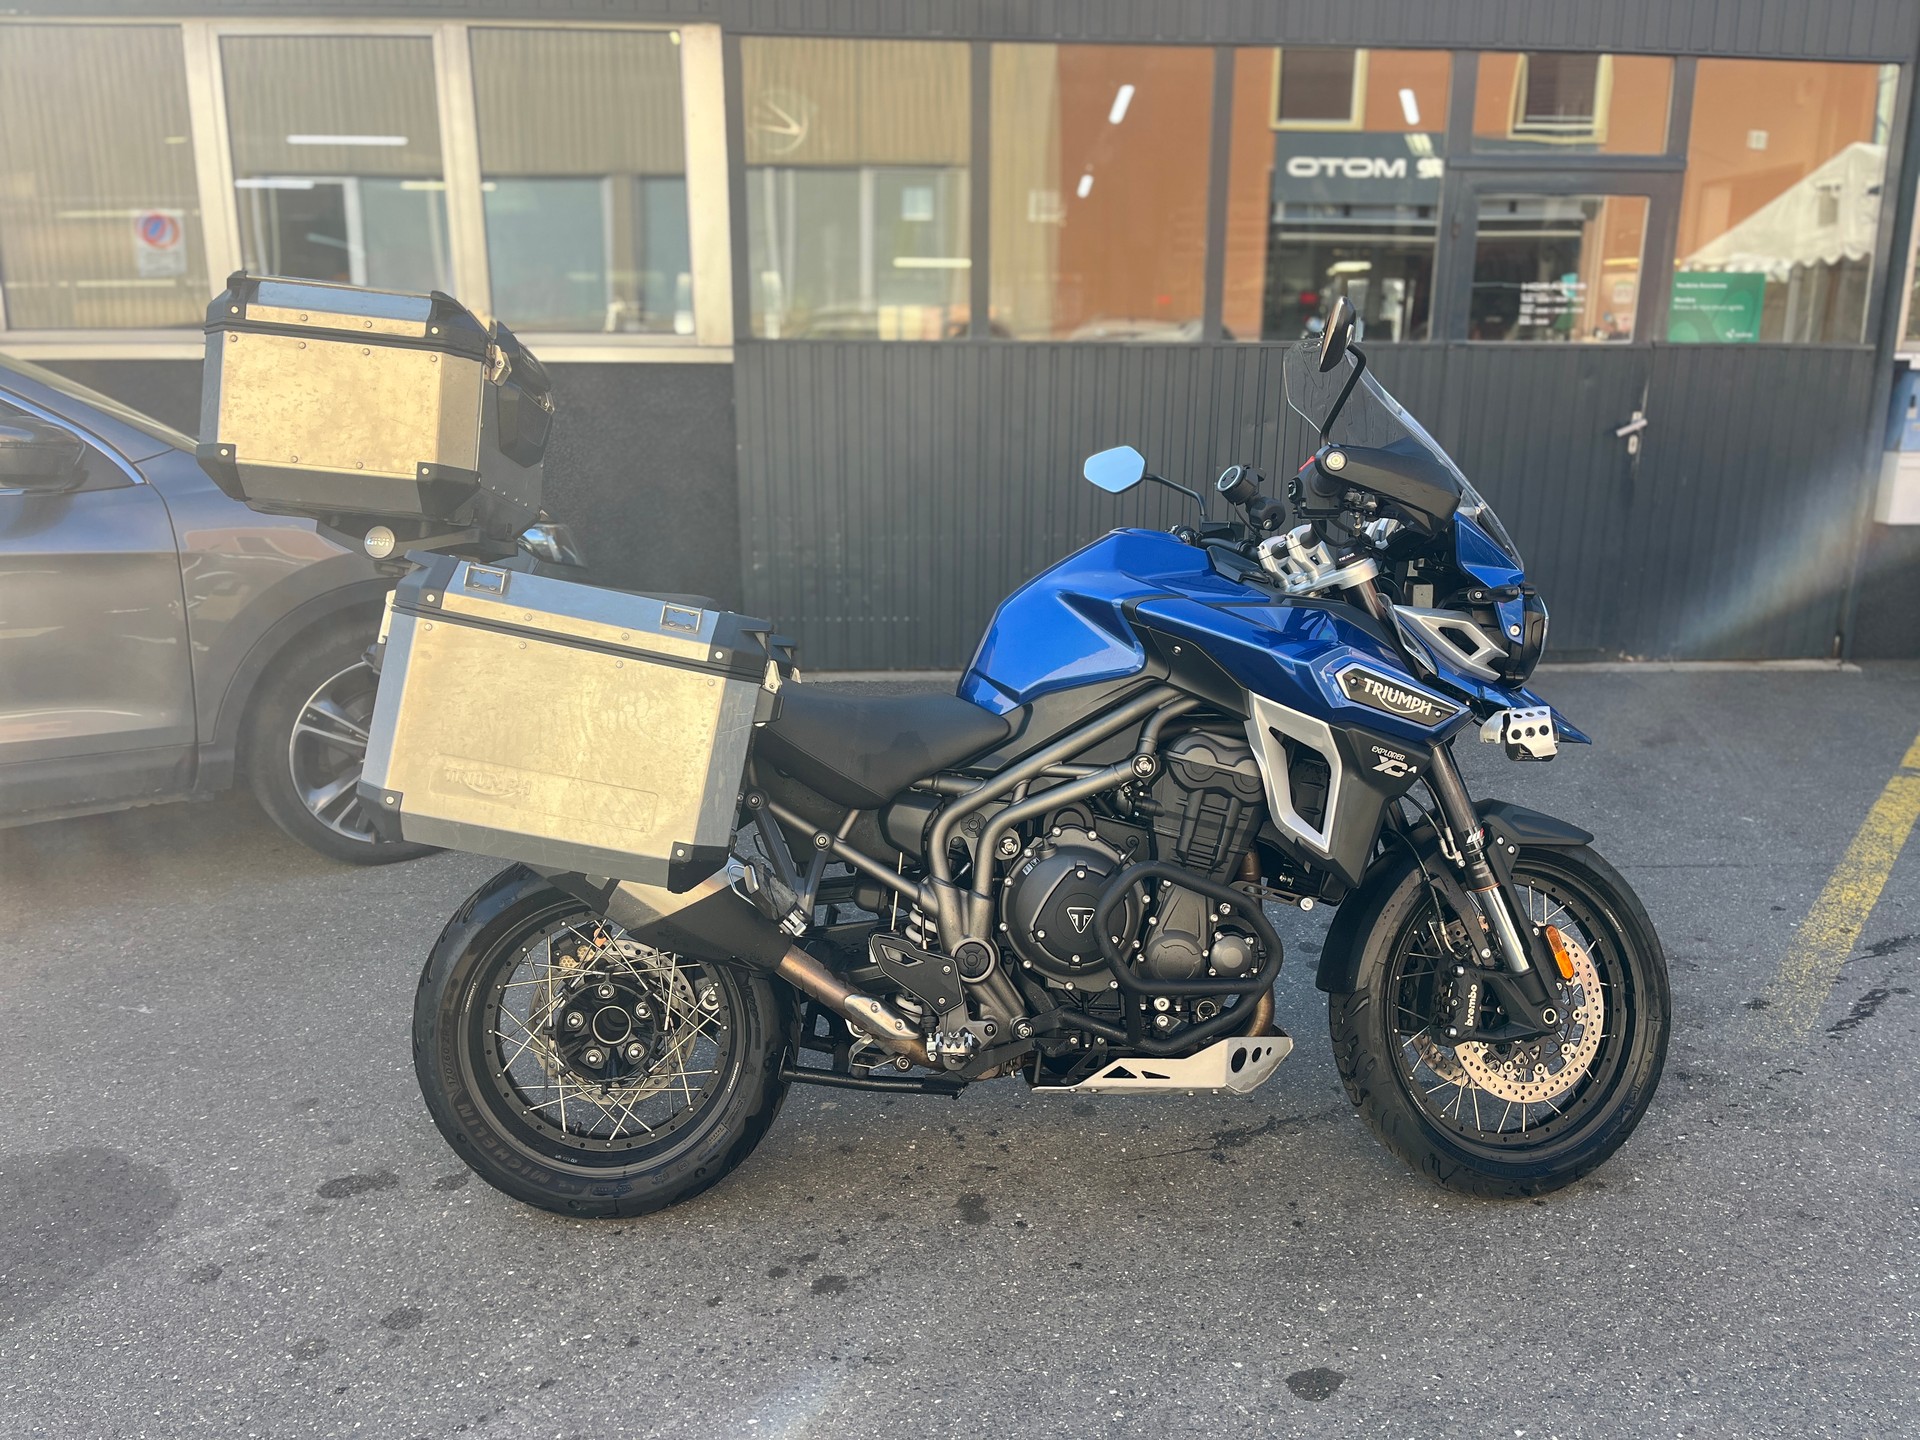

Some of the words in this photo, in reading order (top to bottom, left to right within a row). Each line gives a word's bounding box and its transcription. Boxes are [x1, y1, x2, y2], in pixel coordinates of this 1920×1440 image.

[366, 538, 390, 546] GIVI
[1363, 677, 1433, 716] TRIUMPH
[1371, 745, 1406, 761] EXPLORER
[1464, 984, 1478, 1027] brembo
[455, 1101, 551, 1185] MICHELIN
